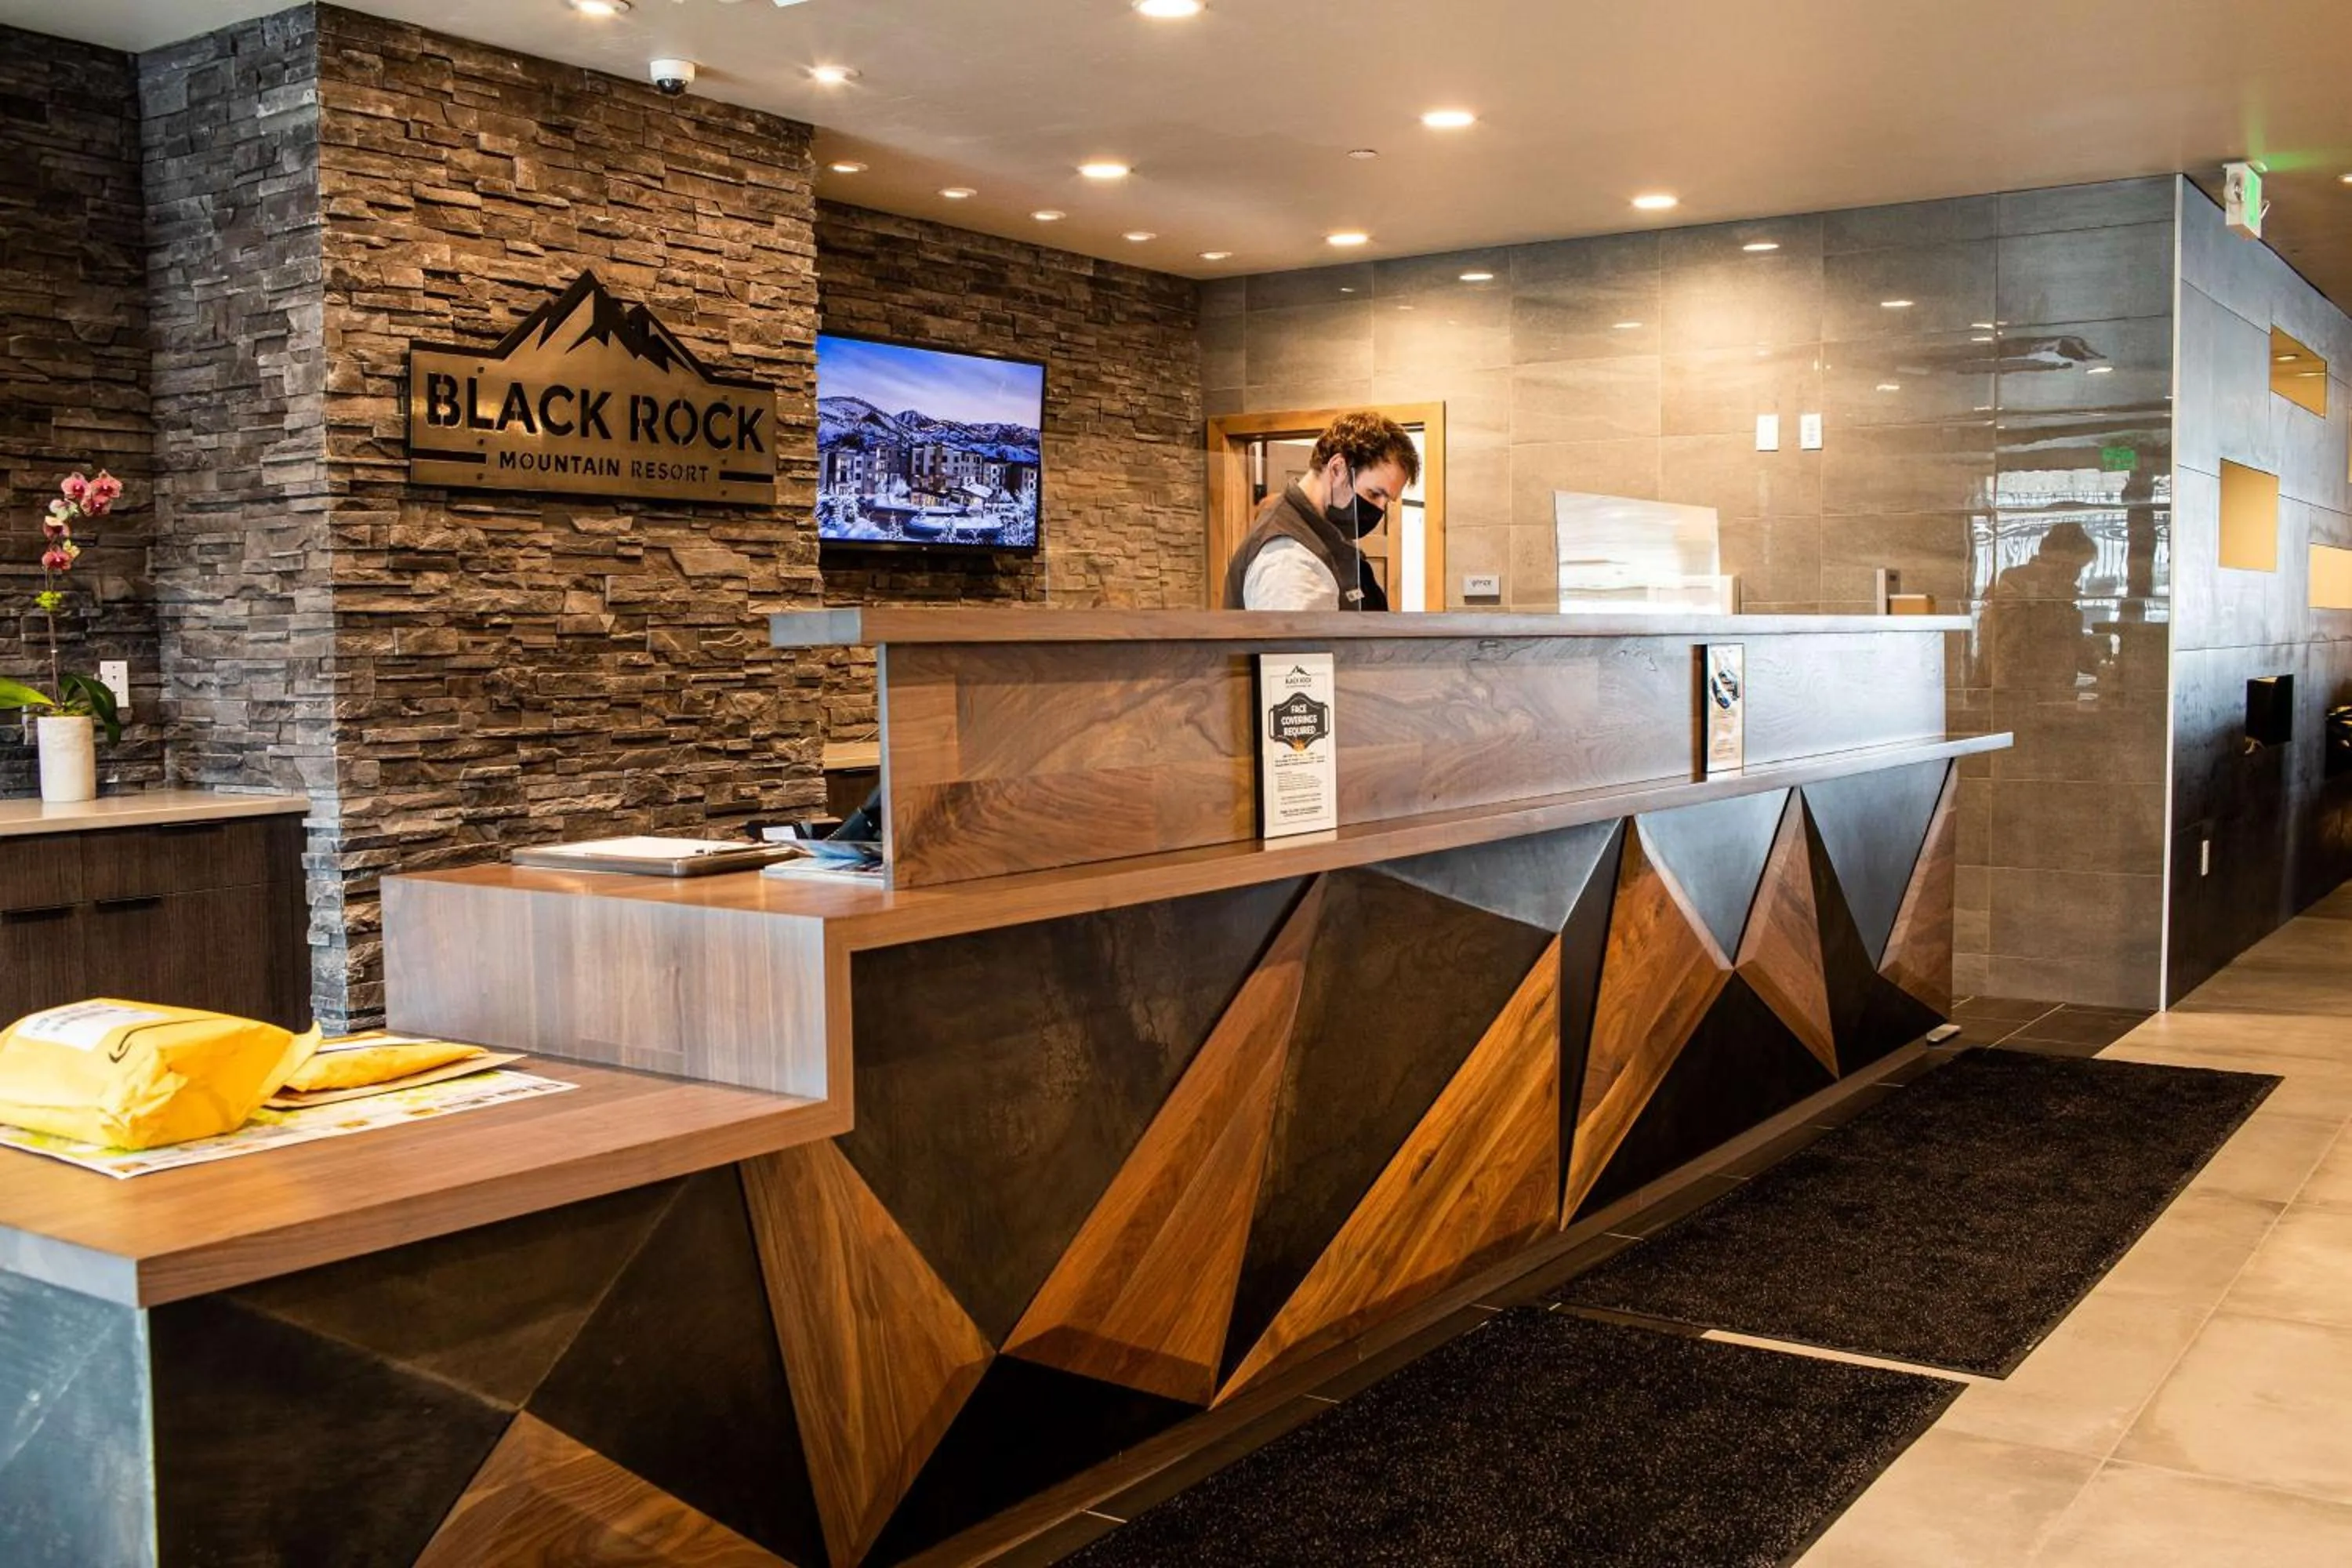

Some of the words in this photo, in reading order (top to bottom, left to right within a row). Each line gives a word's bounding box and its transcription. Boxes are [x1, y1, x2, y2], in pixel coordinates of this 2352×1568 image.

[426, 372, 612, 441] BLACK
[630, 395, 765, 453] ROCK
[499, 450, 620, 477] MOUNTAIN
[630, 460, 710, 483] RESORT
[1290, 704, 1307, 713] FACE
[1280, 714, 1318, 726] COVERINGS
[1283, 725, 1316, 738] REQUIRED
